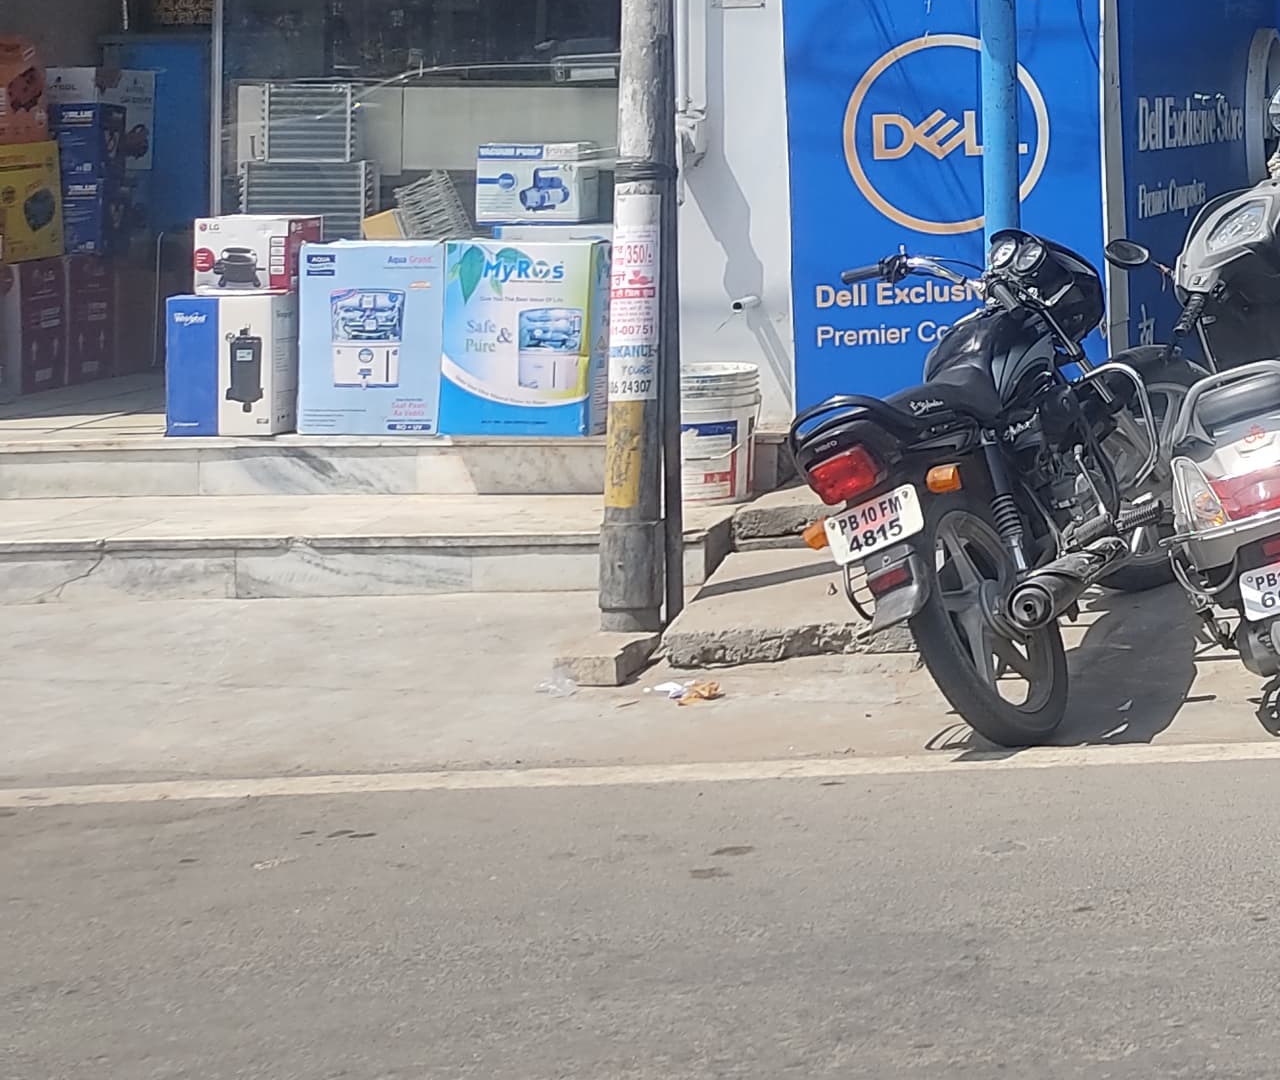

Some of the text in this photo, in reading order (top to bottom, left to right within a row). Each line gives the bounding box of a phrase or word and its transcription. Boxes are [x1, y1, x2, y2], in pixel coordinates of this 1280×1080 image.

[1138, 96, 1244, 152] Dell Exclusive Store
[387, 255, 408, 265] Aqua
[815, 284, 868, 310] Dell
[465, 319, 497, 335] Safe
[816, 322, 912, 348] Premier
[465, 338, 497, 354] Pure
[838, 495, 904, 537] PB 10 FM
[849, 519, 904, 554] 4815
